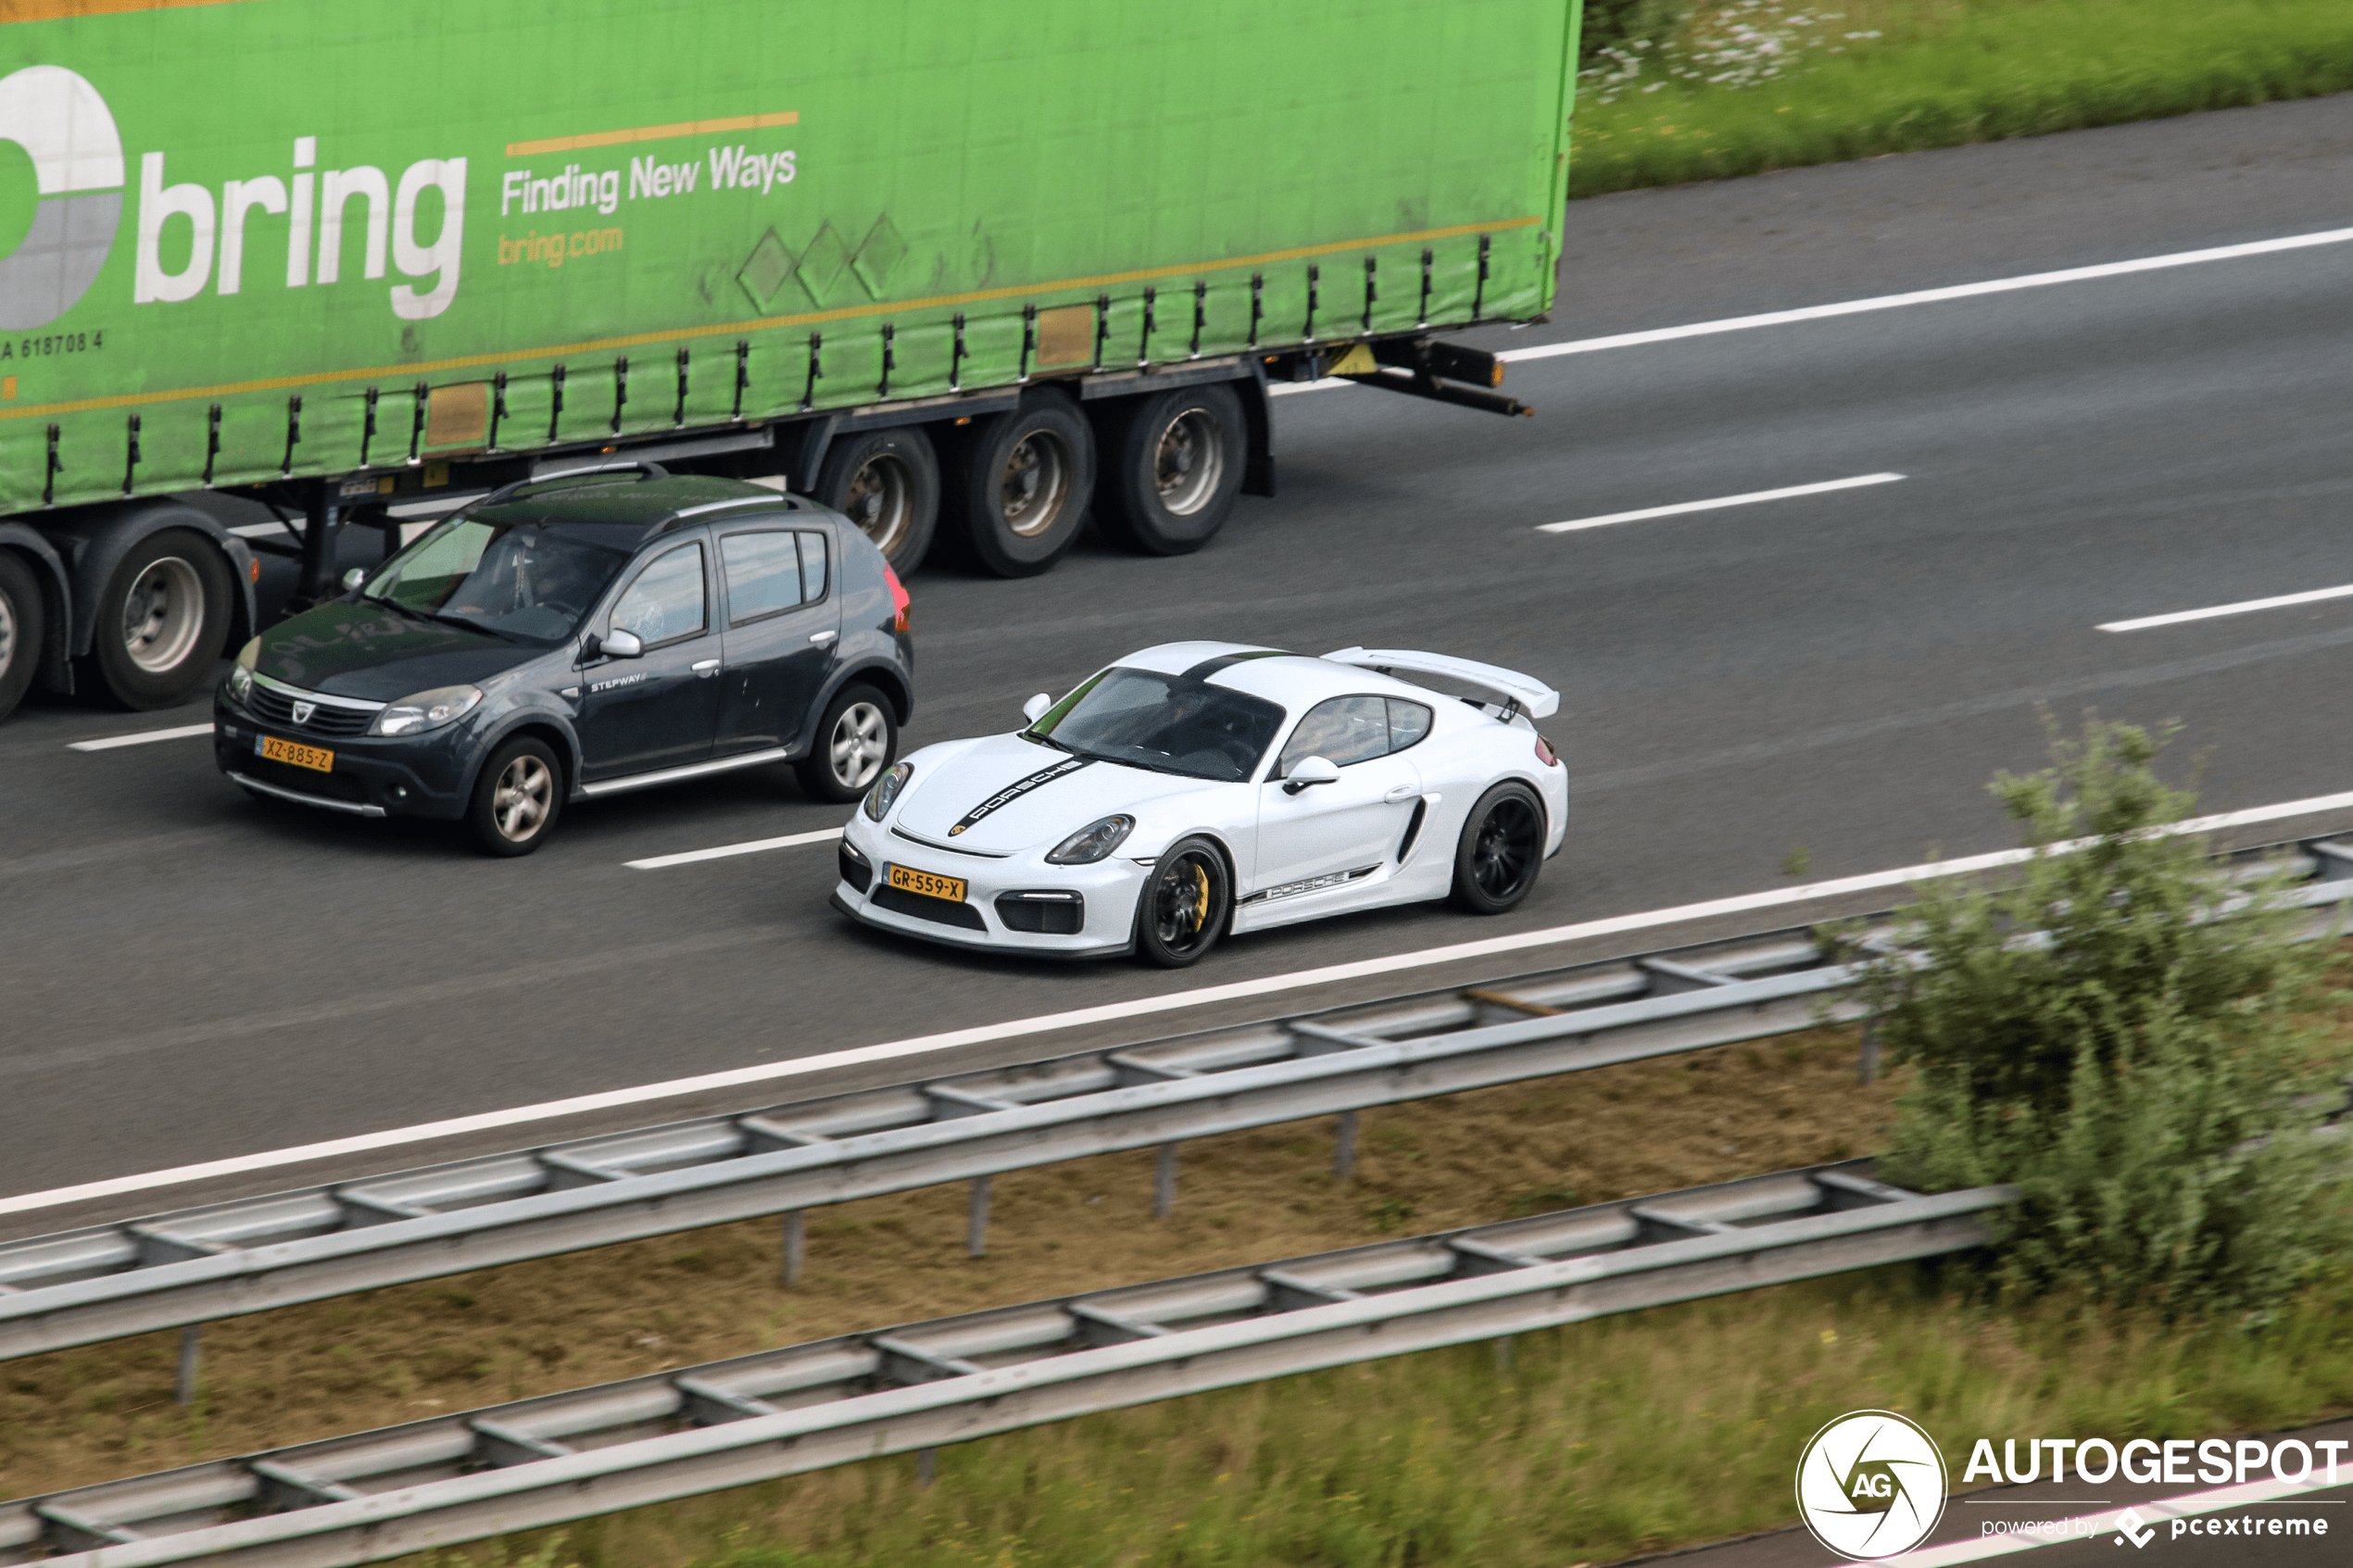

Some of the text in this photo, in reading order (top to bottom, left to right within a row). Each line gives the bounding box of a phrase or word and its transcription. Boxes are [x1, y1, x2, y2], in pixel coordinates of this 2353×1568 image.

[502, 144, 796, 215] Finding New Ways
[134, 135, 467, 320] bring
[498, 229, 623, 268] bring.com
[21, 332, 86, 358] 618708
[93, 330, 103, 350] 4
[591, 673, 641, 693] STEPWAY
[266, 739, 328, 769] XZ-885-Z
[969, 759, 1083, 820] PORSCHE
[893, 869, 959, 898] GR-559-X
[1271, 872, 1345, 897] PORSCHE
